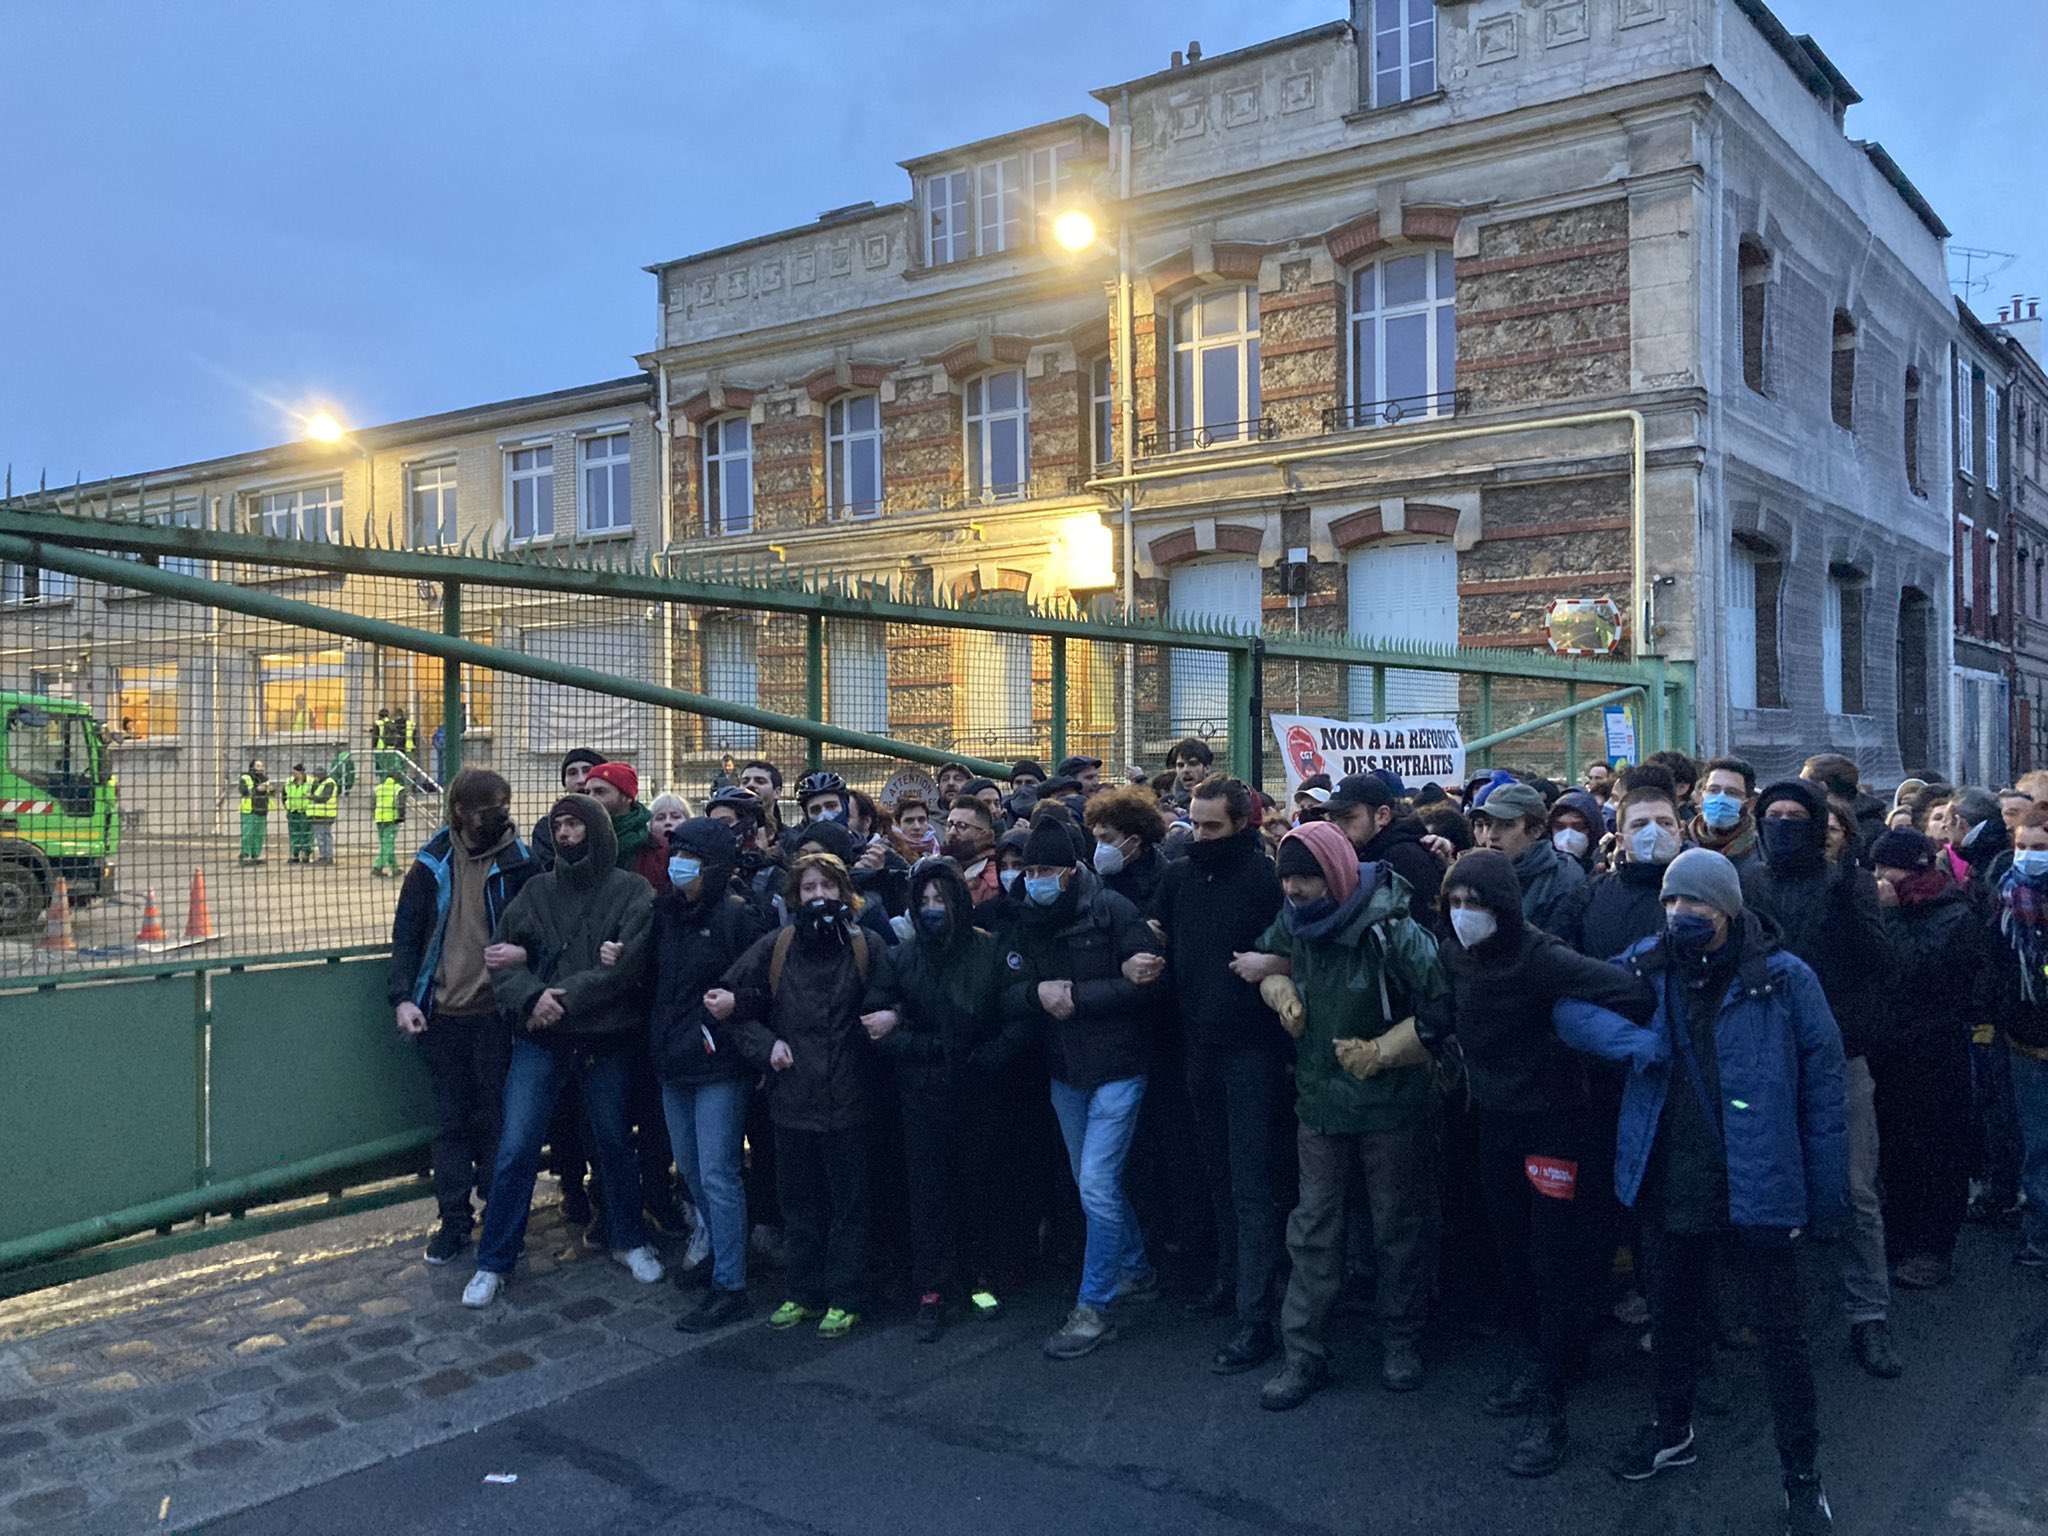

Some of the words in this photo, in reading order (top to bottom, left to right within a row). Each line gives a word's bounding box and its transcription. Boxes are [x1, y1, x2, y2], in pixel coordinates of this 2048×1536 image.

[1320, 727, 1364, 750] NON
[1369, 728, 1381, 750] A
[1383, 729, 1406, 749] LA
[1300, 750, 1314, 760] CGT
[1343, 755, 1377, 775] DES
[1381, 754, 1454, 777] RETRAITES
[889, 773, 933, 797] ATTENTION
